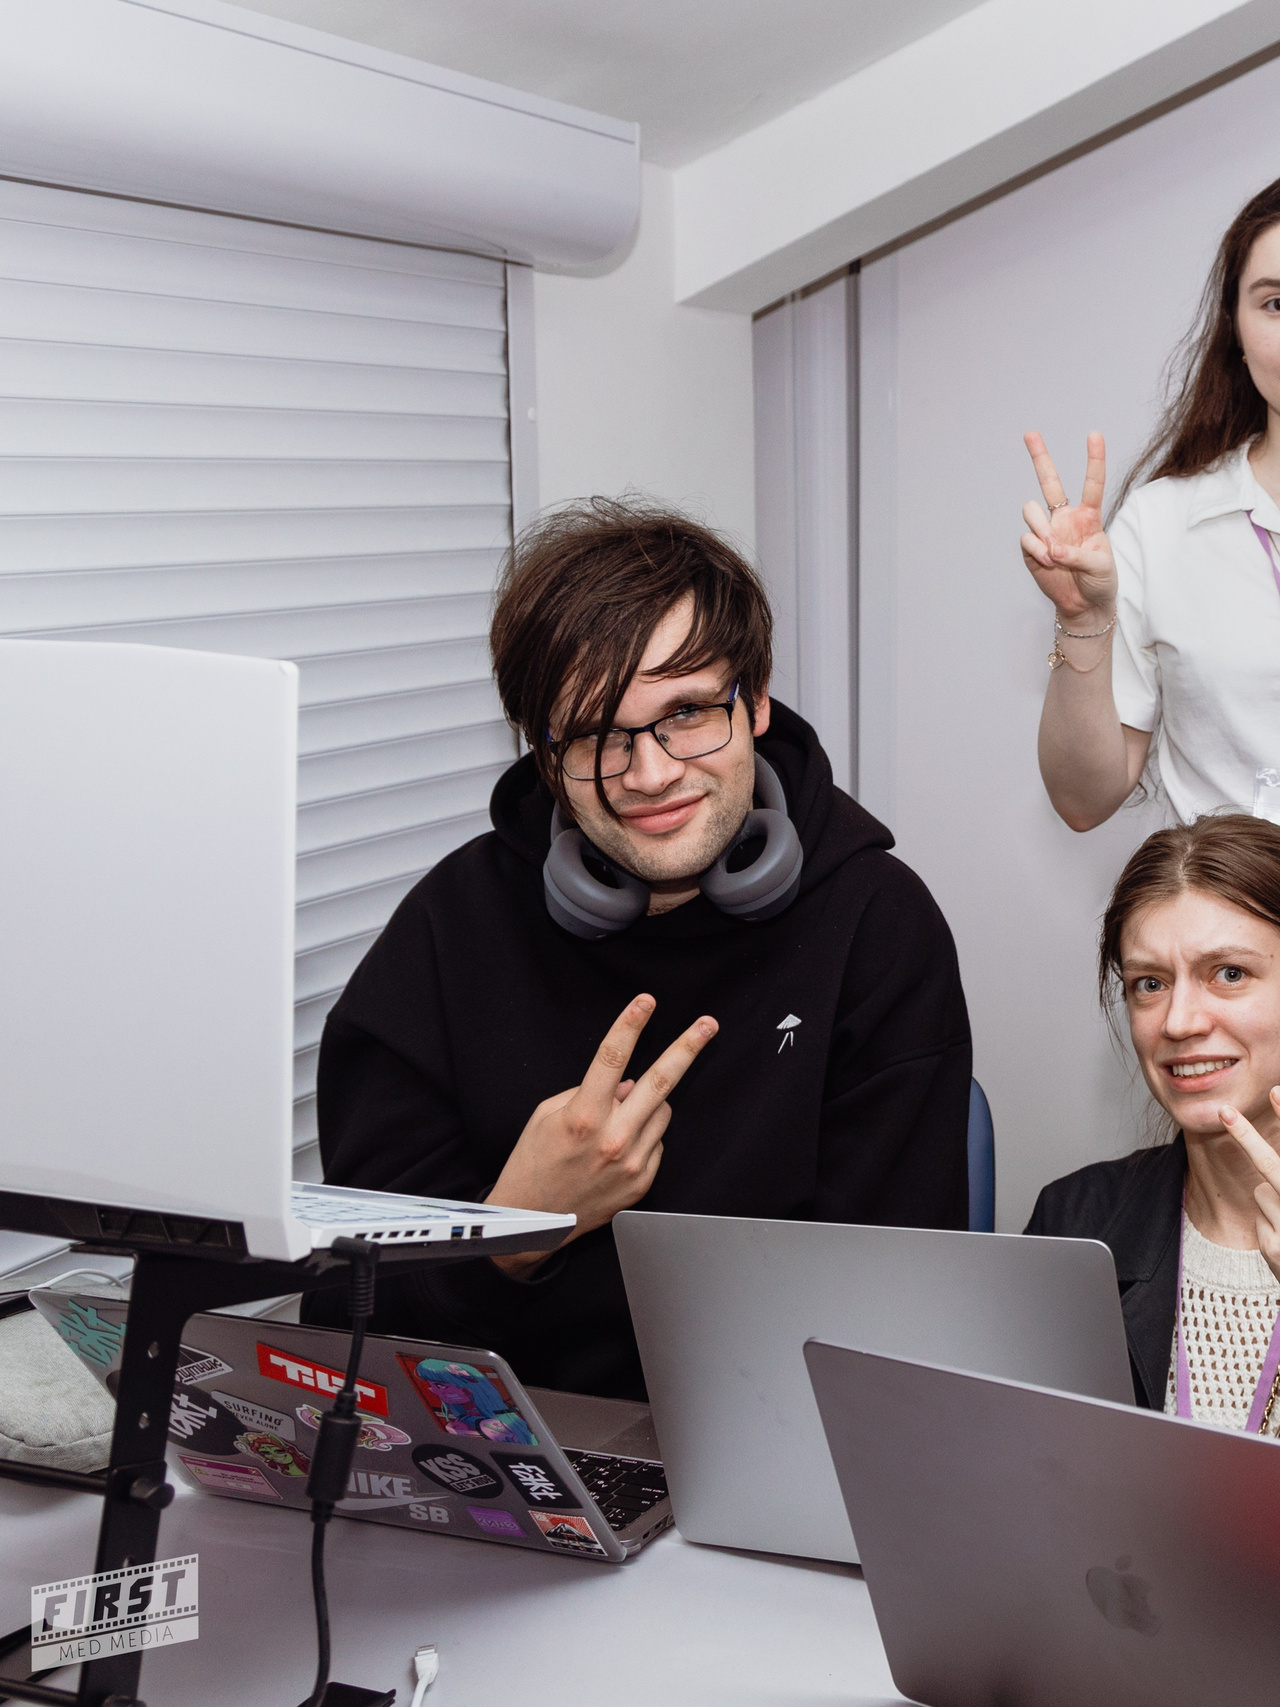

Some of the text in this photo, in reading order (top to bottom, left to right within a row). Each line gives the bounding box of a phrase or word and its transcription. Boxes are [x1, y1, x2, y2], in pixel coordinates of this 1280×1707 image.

[223, 1400, 283, 1426] SURFING
[256, 1420, 279, 1431] ALONE
[419, 1453, 480, 1483] KSS
[408, 1503, 450, 1524] SB
